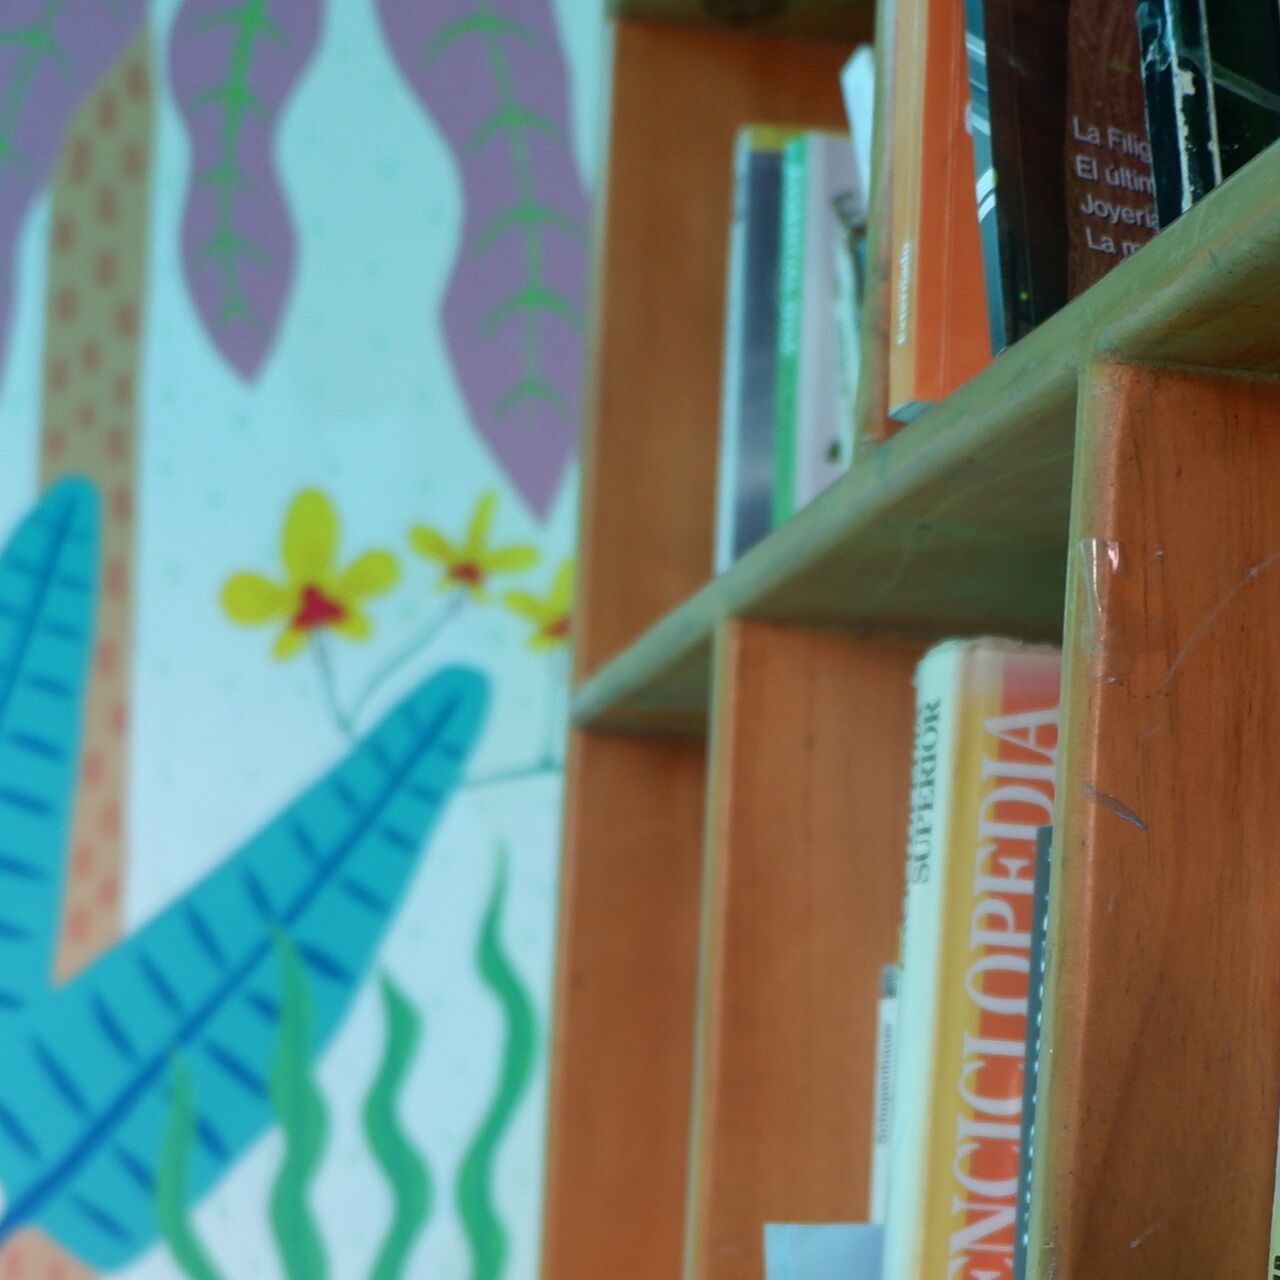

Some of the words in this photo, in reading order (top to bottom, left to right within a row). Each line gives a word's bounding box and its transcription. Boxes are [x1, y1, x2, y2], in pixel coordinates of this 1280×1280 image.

[1073, 116, 1100, 146] La
[1076, 154, 1099, 181] El
[1086, 226, 1116, 255] La
[908, 696, 942, 886] SUPERIOR
